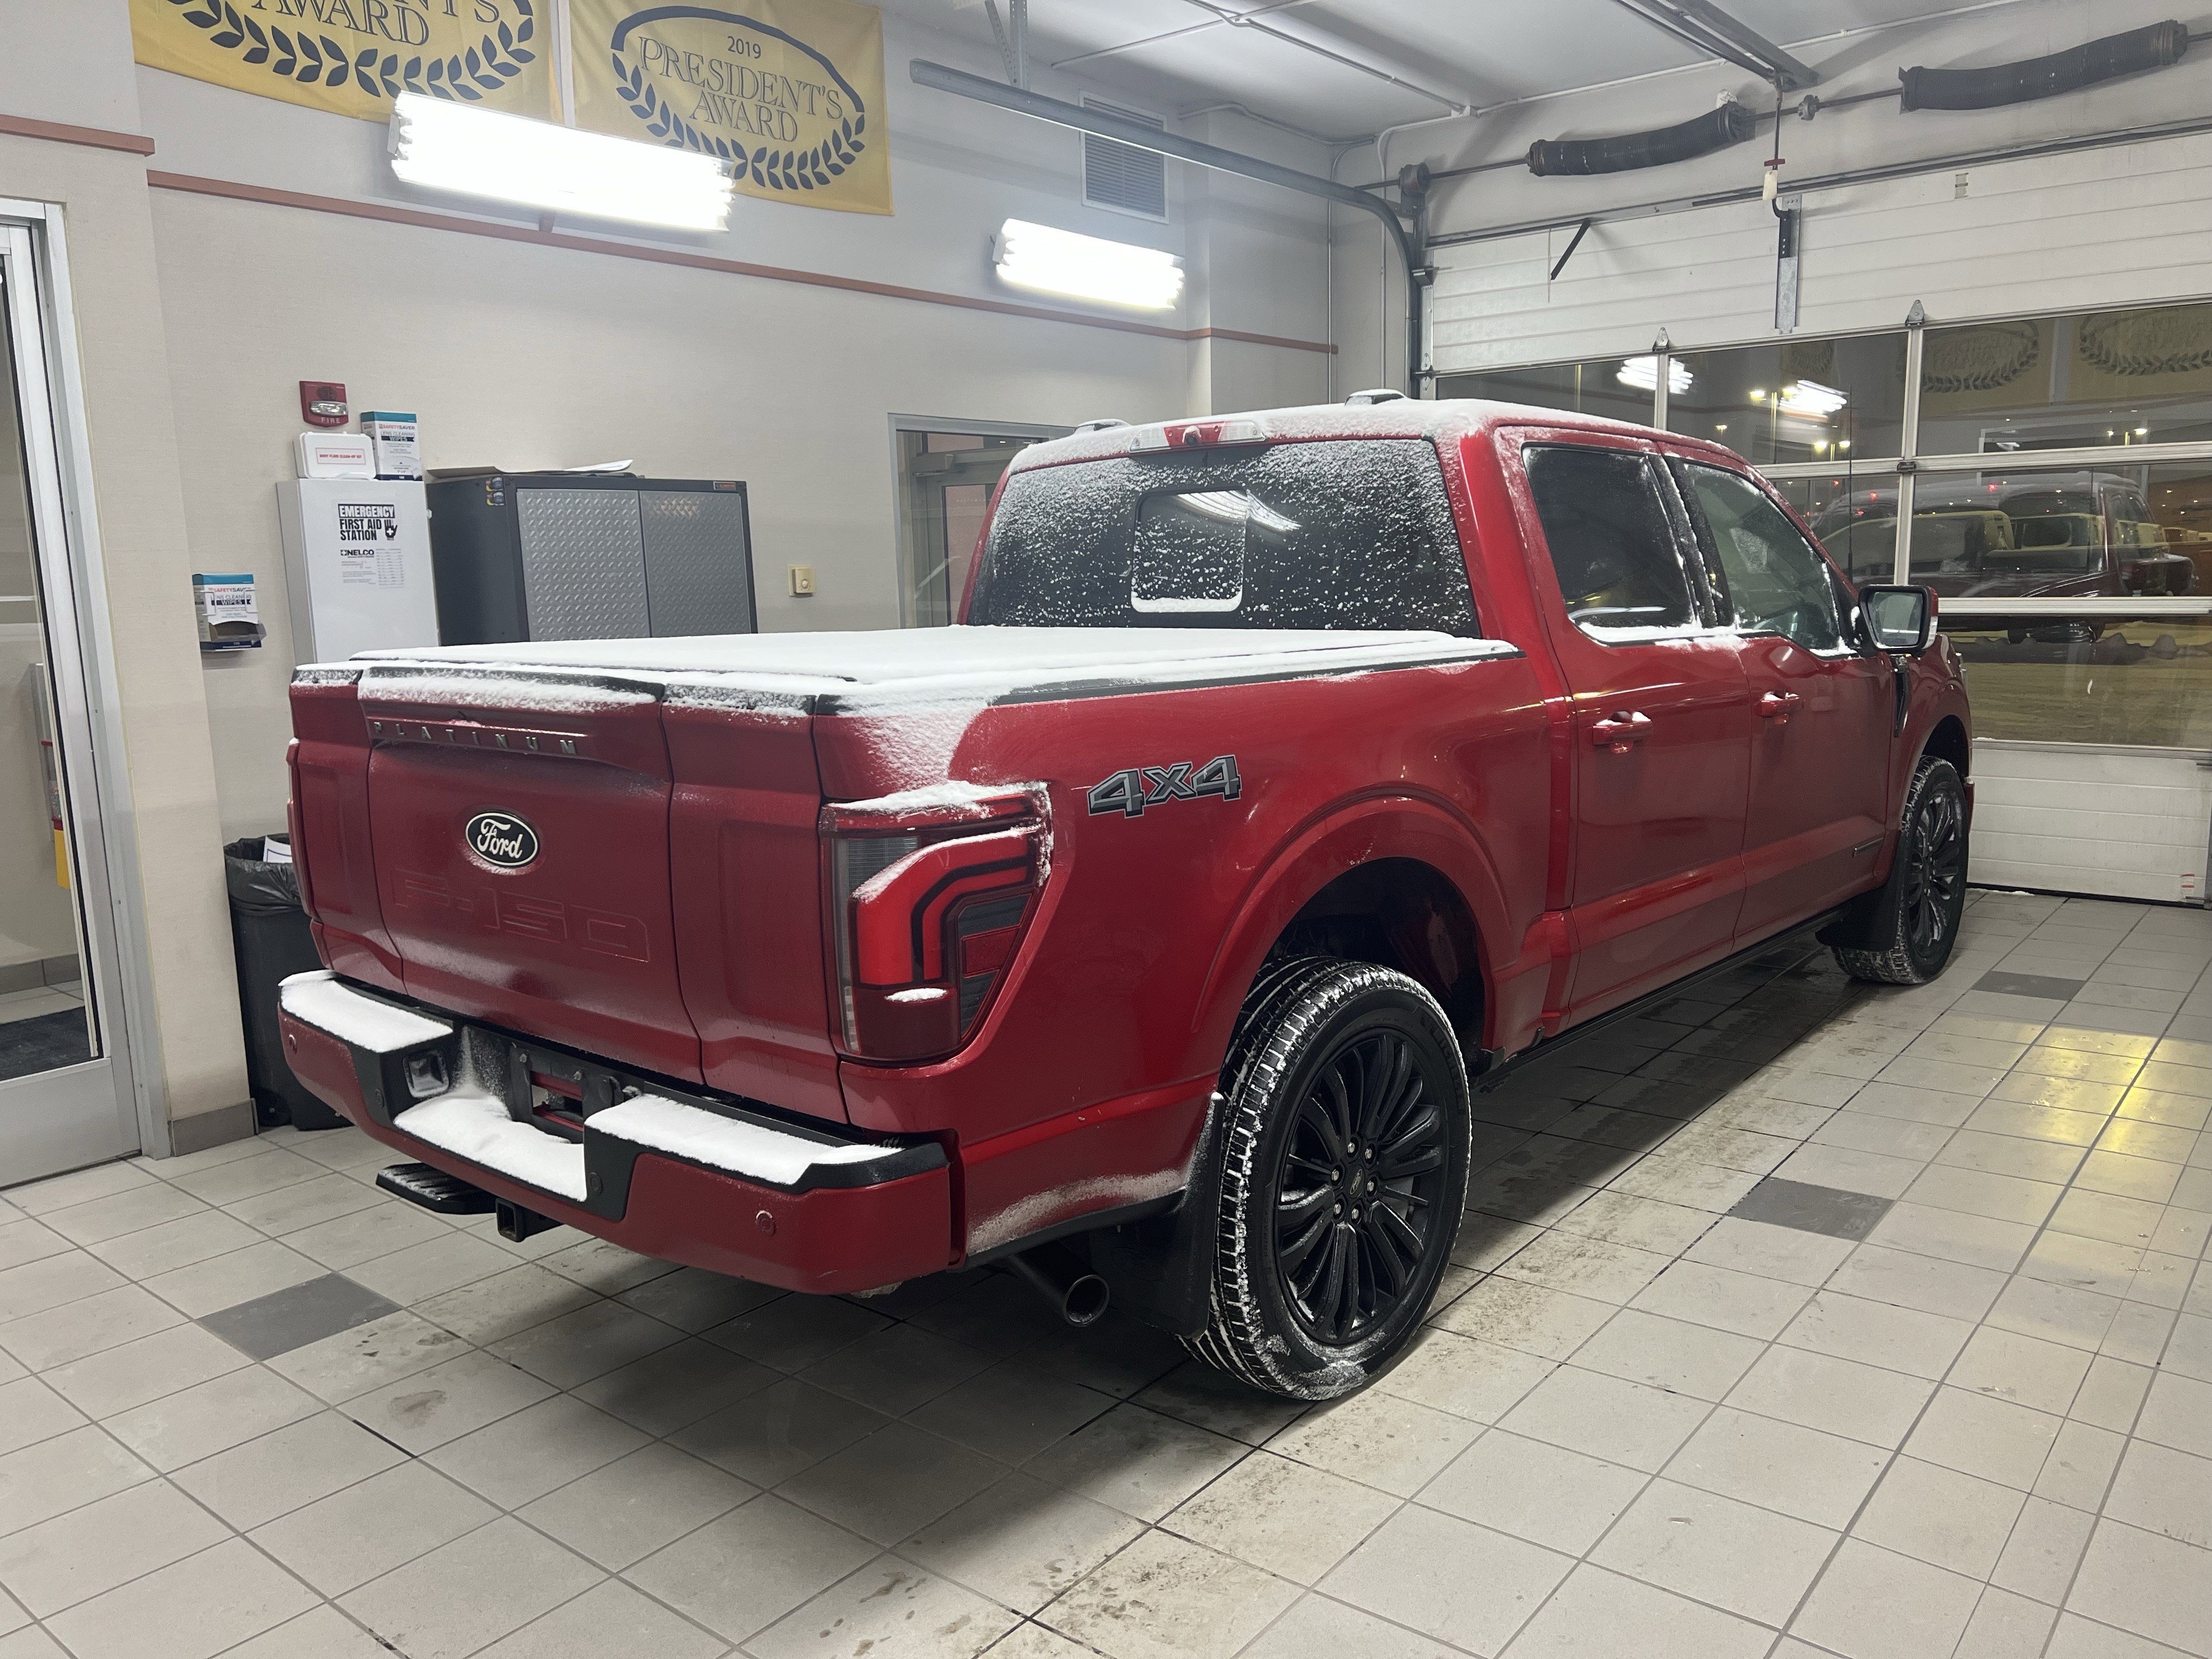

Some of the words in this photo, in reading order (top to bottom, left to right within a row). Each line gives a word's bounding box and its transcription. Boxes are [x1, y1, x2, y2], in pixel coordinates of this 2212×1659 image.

[727, 36, 761, 59] 2019
[638, 36, 843, 120] PRESIDENT'S
[689, 90, 798, 142] AWARD
[339, 505, 394, 517] EMERGENCY
[340, 519, 364, 529] FIRST
[367, 519, 382, 529] AID
[340, 530, 377, 540] STATION
[374, 721, 577, 755] PLATINUM
[477, 817, 523, 860] Ford
[390, 868, 651, 963] F-150
